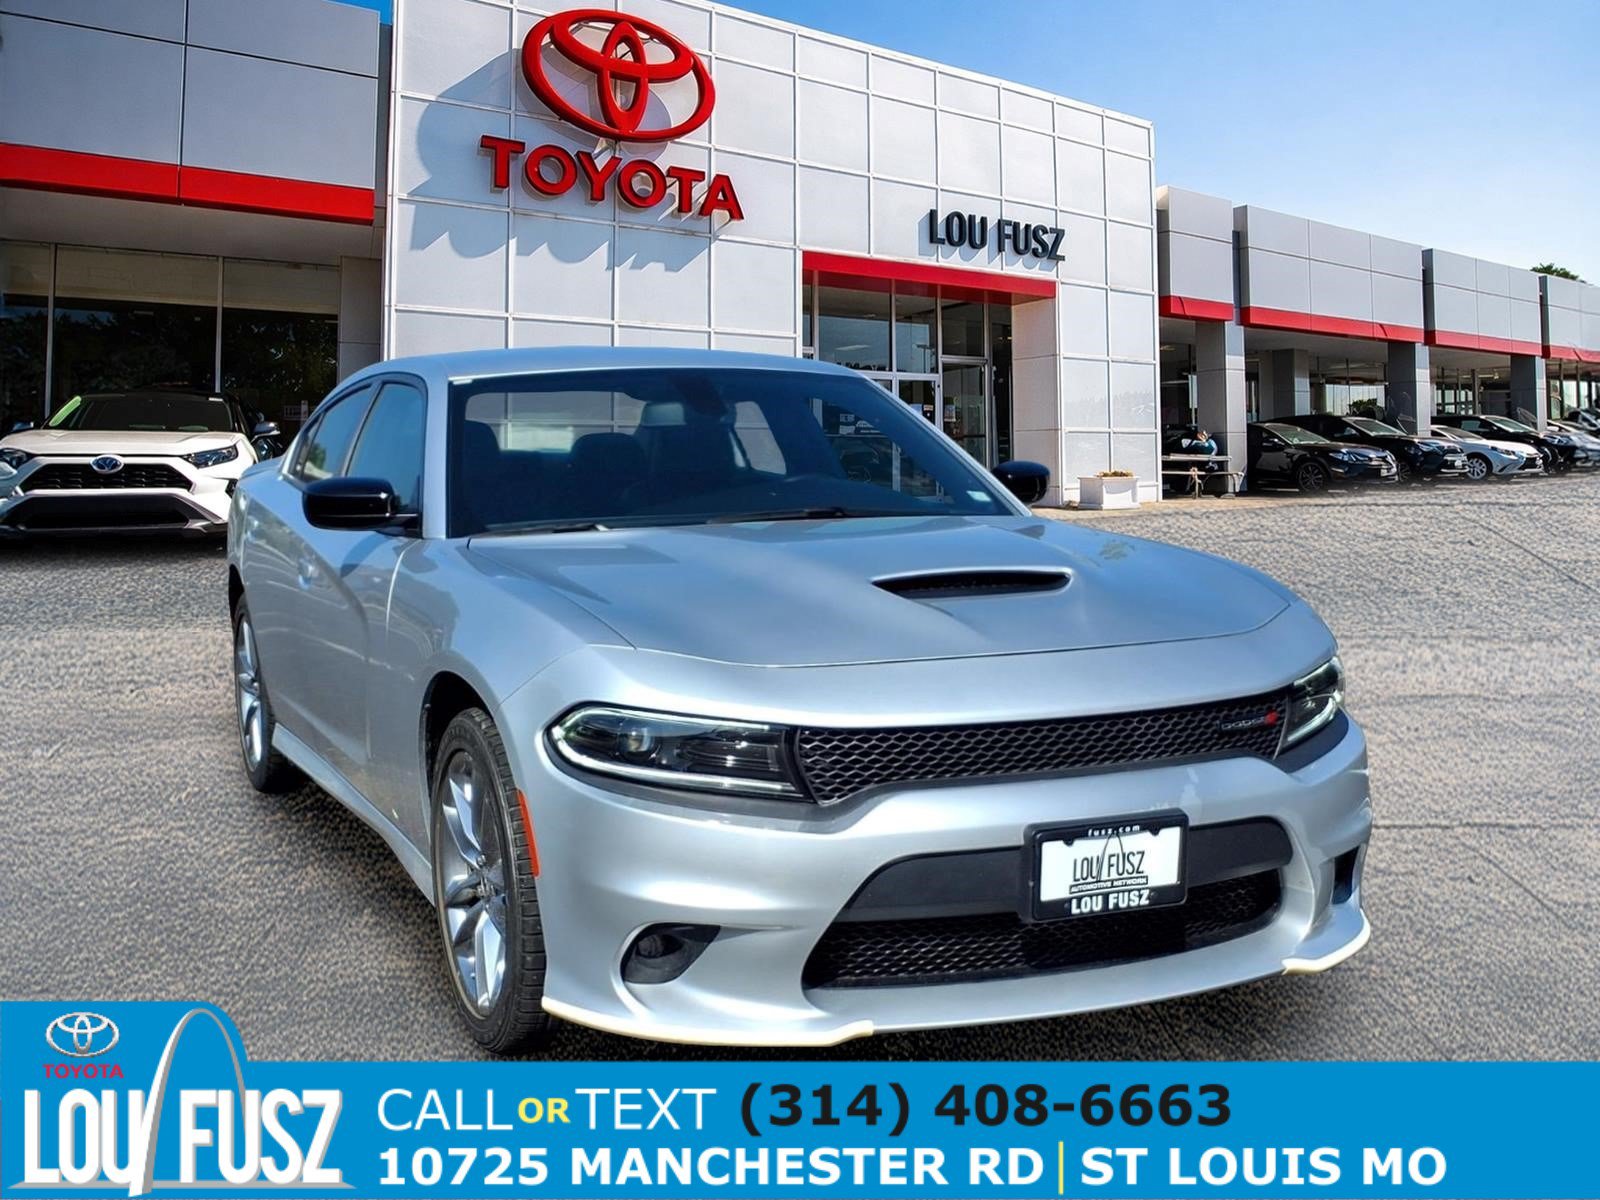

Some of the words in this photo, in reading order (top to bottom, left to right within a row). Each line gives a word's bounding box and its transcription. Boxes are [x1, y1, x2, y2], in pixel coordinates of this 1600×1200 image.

[479, 134, 744, 221] TOYOTA
[929, 209, 988, 250] LOU
[997, 218, 1066, 262] FUSZ
[1087, 824, 1140, 837] fusz.com
[1072, 854, 1101, 882] LOU
[1107, 850, 1146, 878] FUSZ
[1070, 894, 1103, 915] LOU
[1108, 889, 1150, 910] FUSZ
